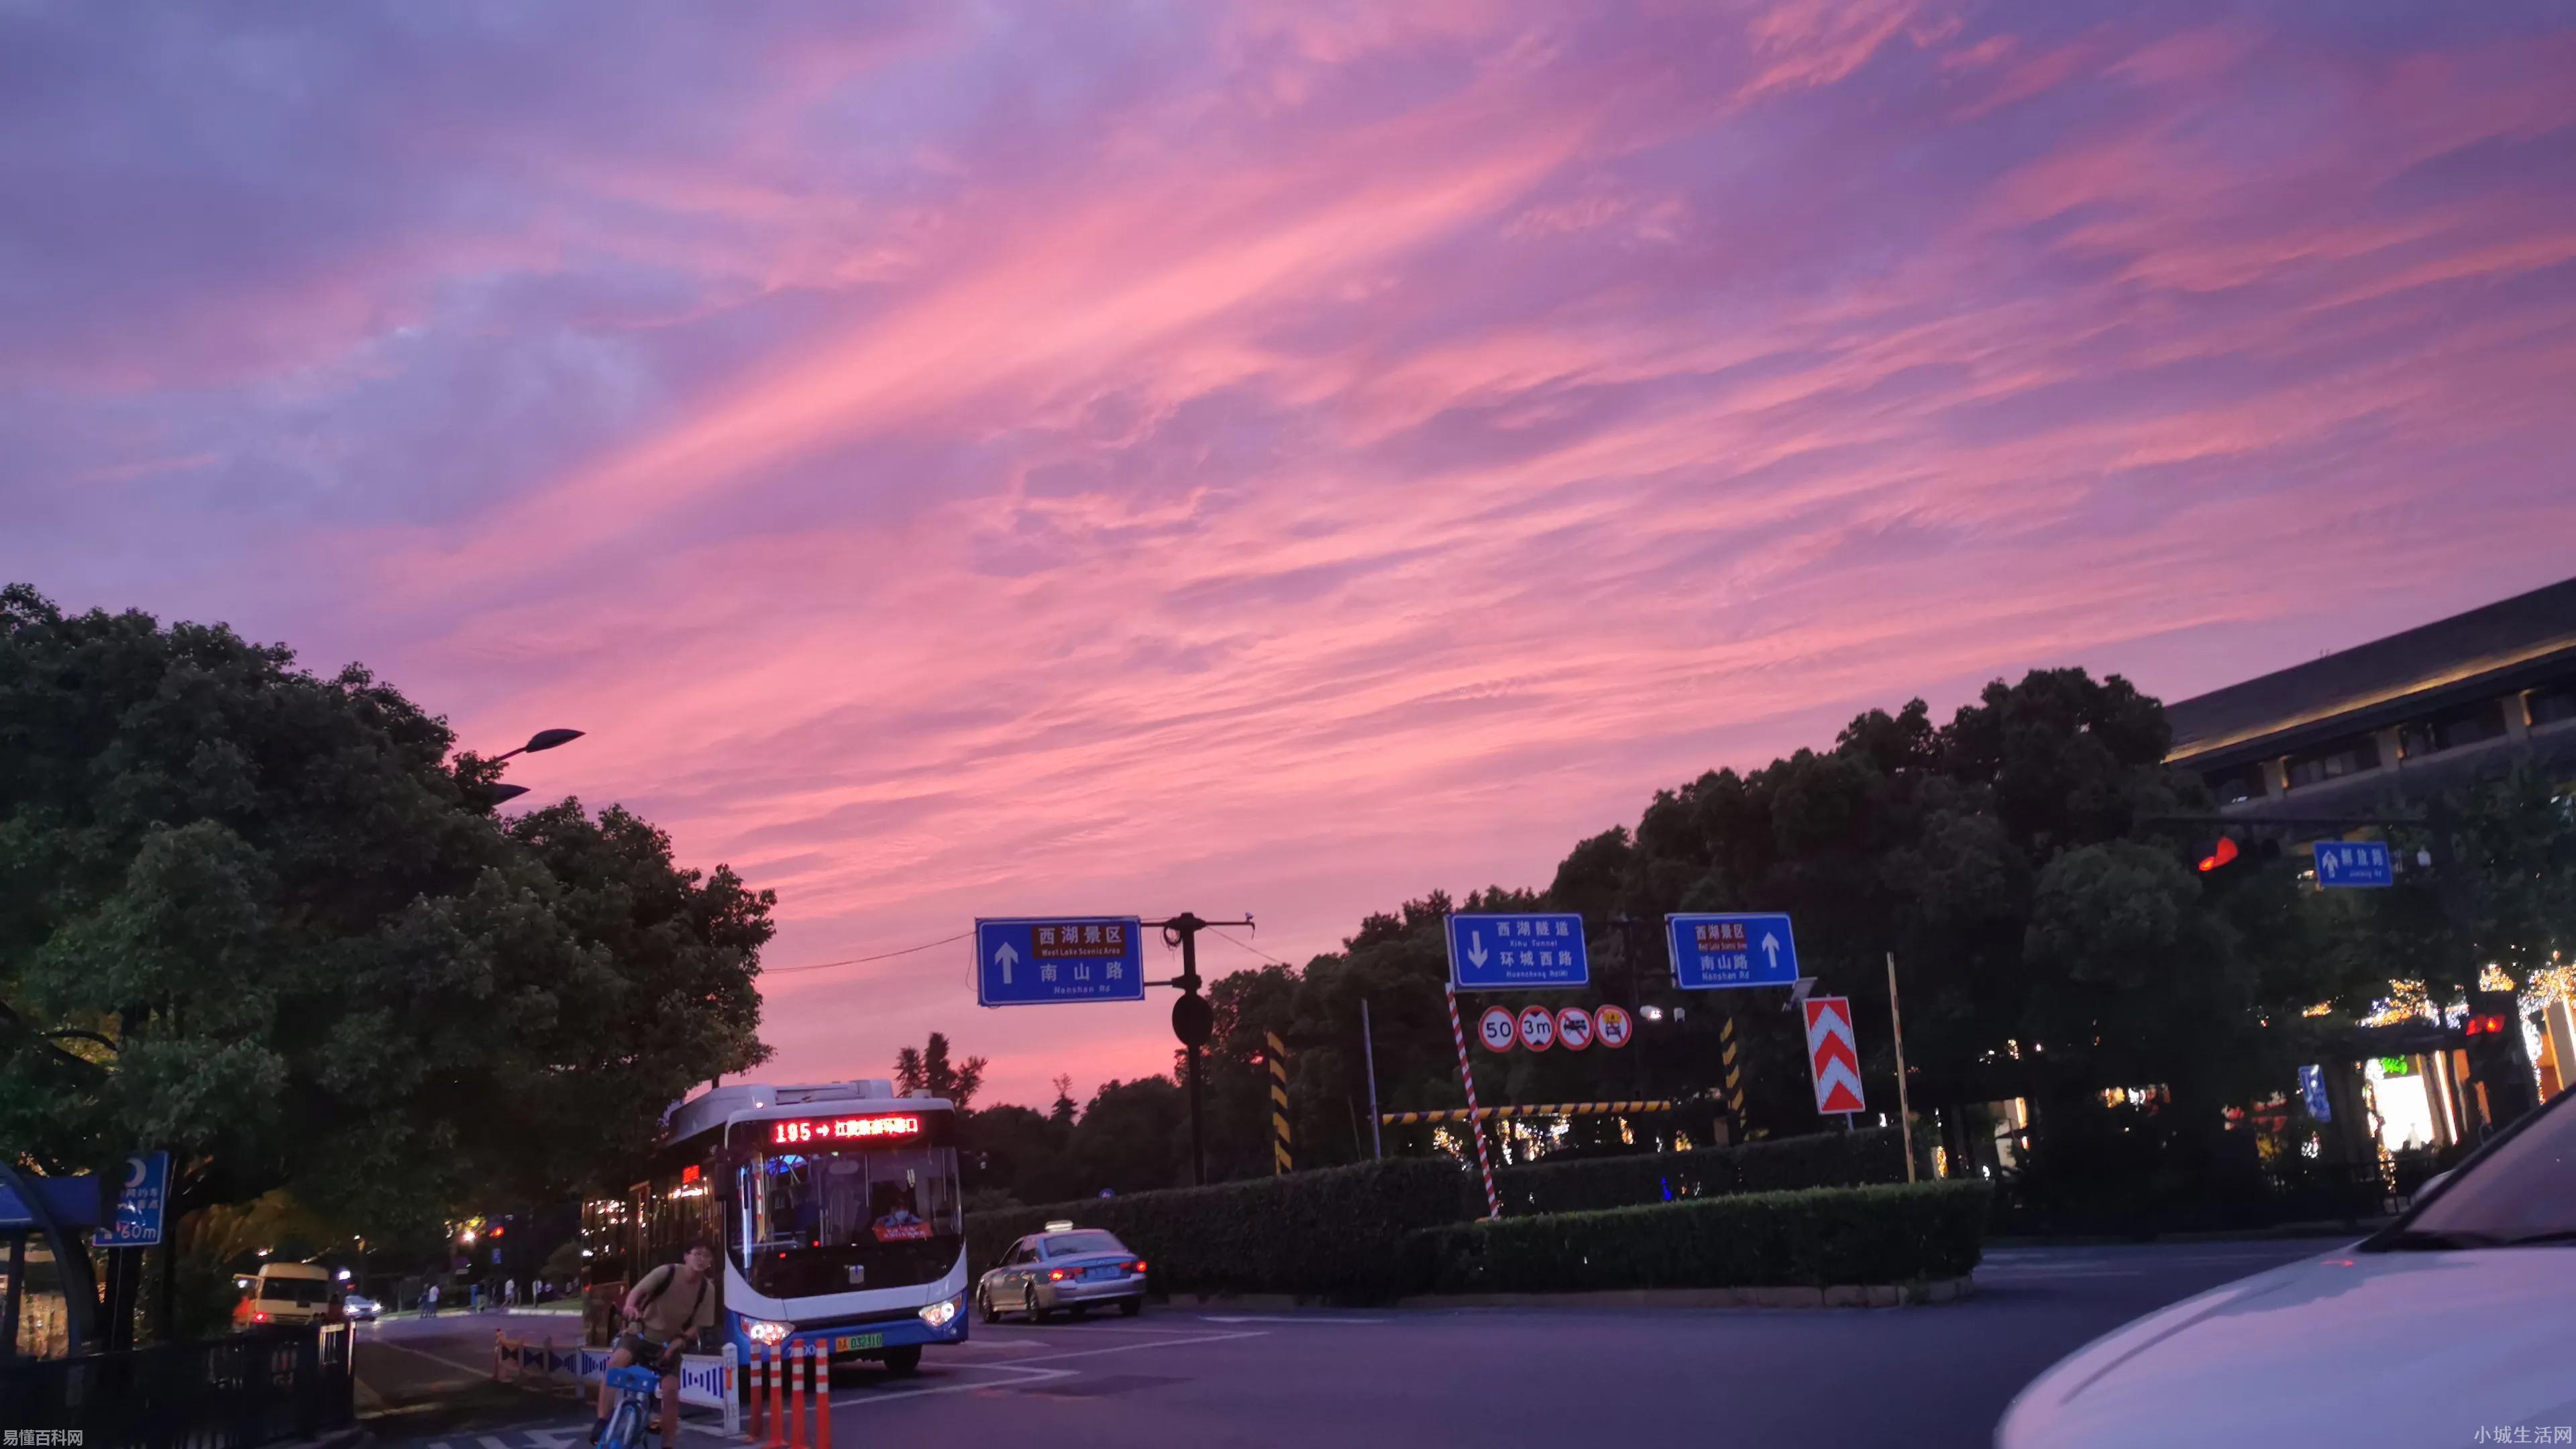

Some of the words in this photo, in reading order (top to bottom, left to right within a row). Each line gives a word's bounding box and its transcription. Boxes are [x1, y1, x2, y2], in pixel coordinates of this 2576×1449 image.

[1039, 926, 1122, 945] 西湖景区
[1497, 921, 1570, 936] 西湖隧道
[1695, 924, 1745, 941] 西湖景区
[1060, 948, 1077, 956] Lake
[1078, 947, 1103, 956] Scenic
[1500, 951, 1572, 967] 环城西路
[1701, 954, 1748, 971] 南山路
[1040, 961, 1124, 983] 南山路
[1054, 986, 1095, 994] Nanshan
[1099, 985, 1111, 993] Rd
[1486, 1022, 1511, 1038] 50
[1523, 1020, 1551, 1035] 3m
